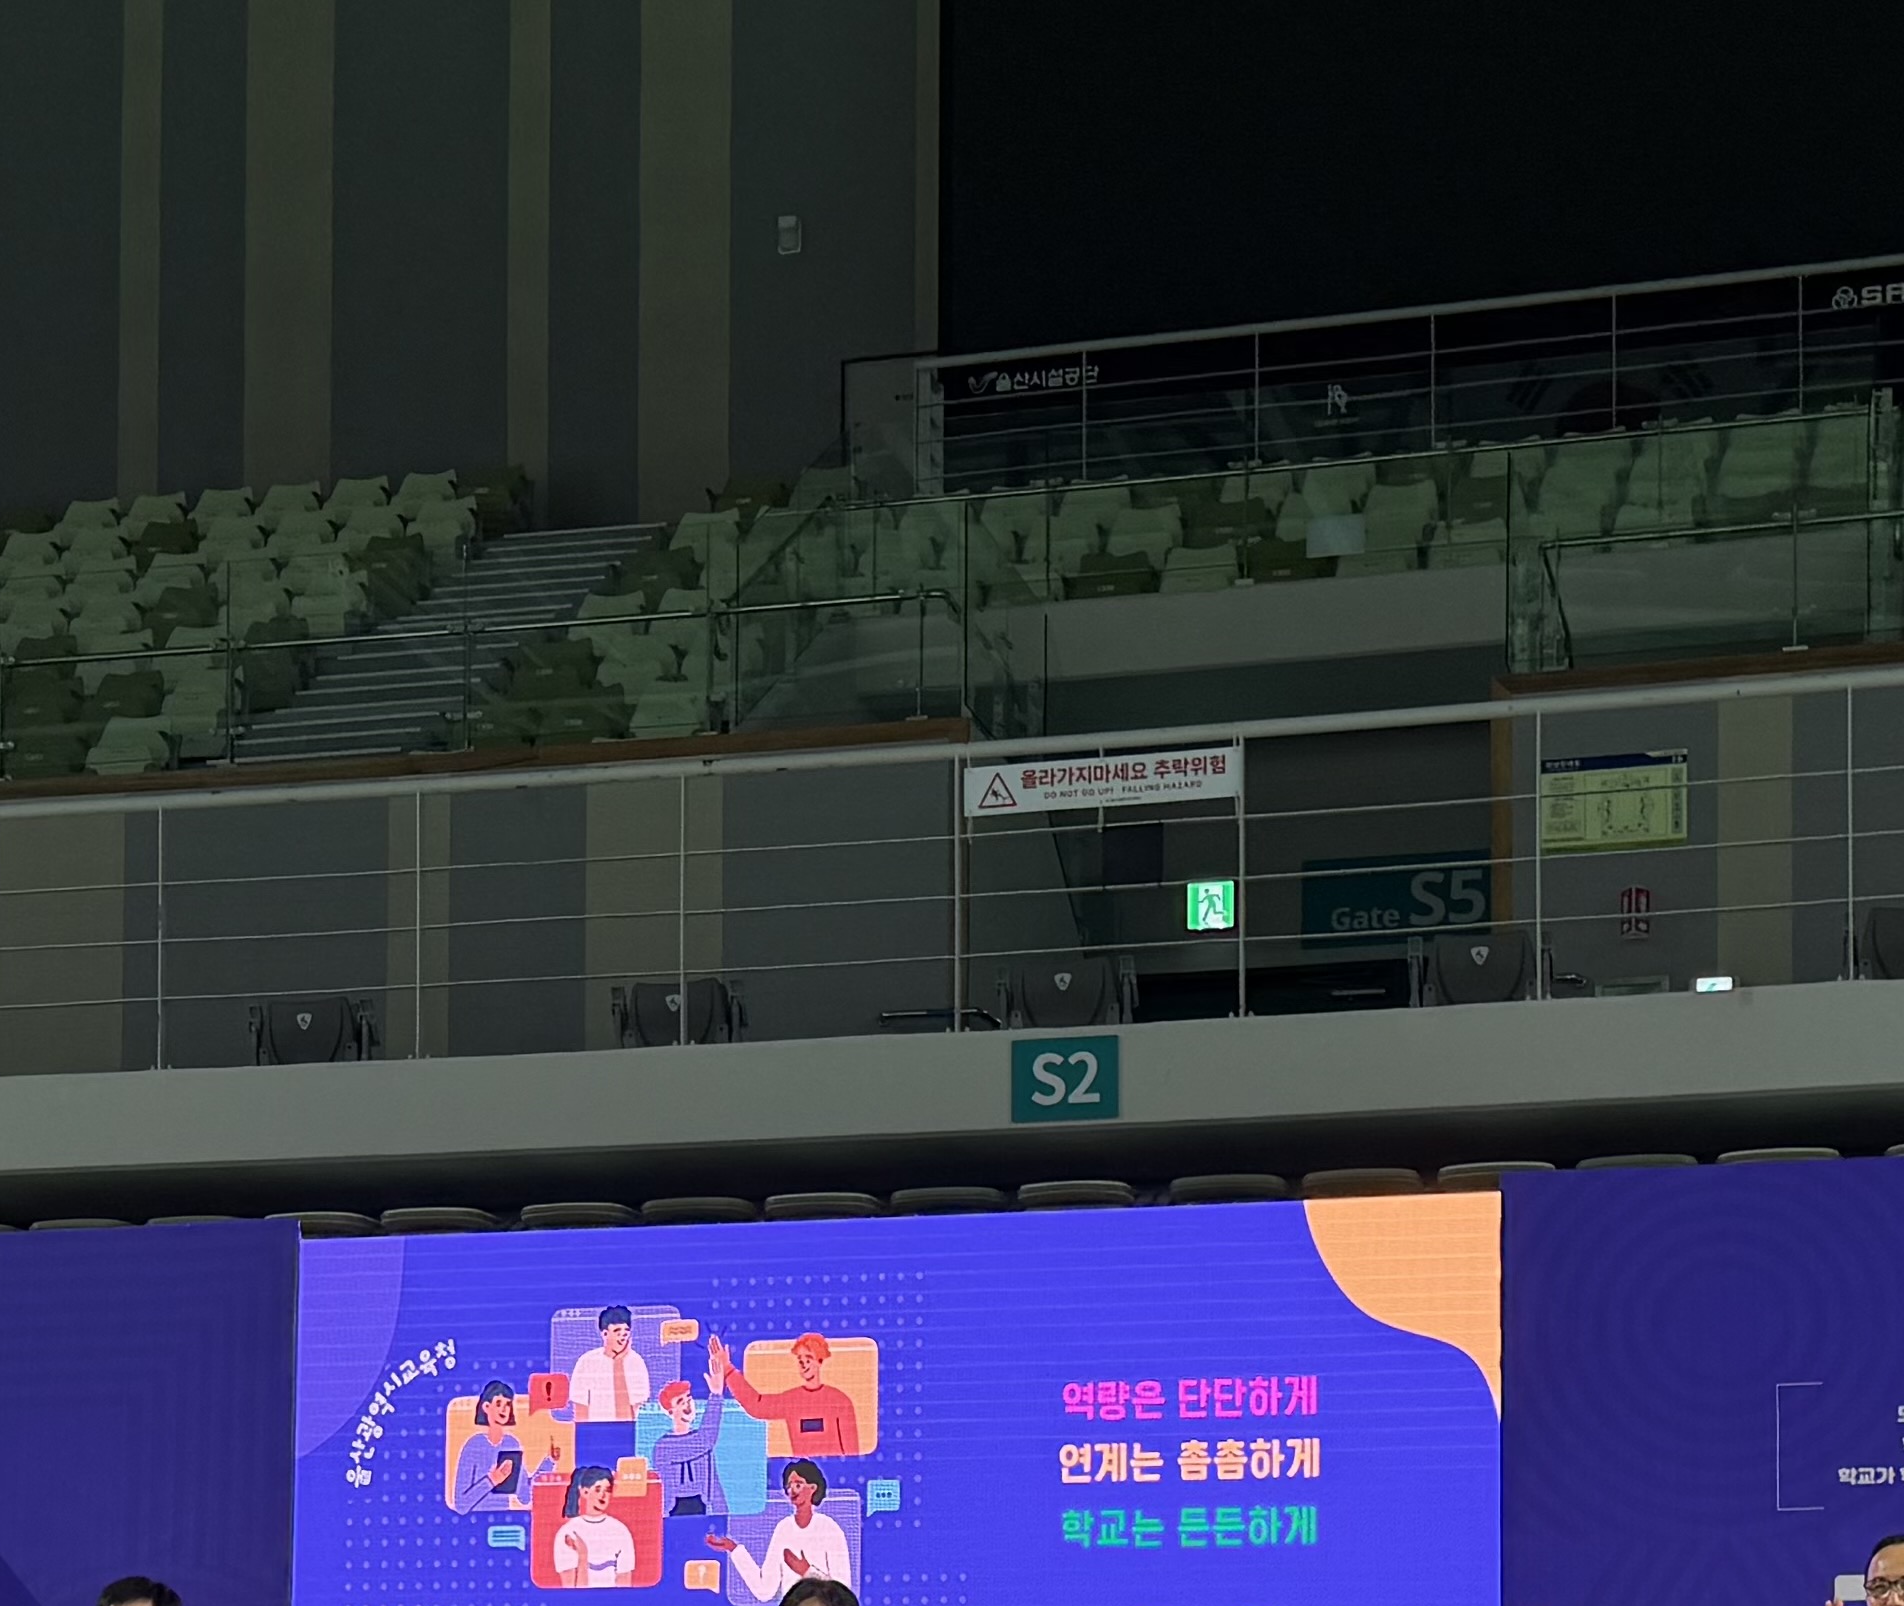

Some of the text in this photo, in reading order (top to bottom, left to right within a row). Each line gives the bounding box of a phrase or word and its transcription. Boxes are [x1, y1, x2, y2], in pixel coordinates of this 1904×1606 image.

[1020, 754, 1228, 789] 올라가지마세요 추락위험
[1331, 869, 1487, 932] Gate S5
[1031, 1053, 1101, 1107] S2
[346, 1338, 456, 1488] 울산광역시교육청
[1062, 1375, 1318, 1421] 역량은 단단하게
[1059, 1437, 1321, 1484] 연계는 촘촘하게
[1837, 1466, 1896, 1486] 학교가
[1062, 1505, 1318, 1549] 학교는 든든하게
